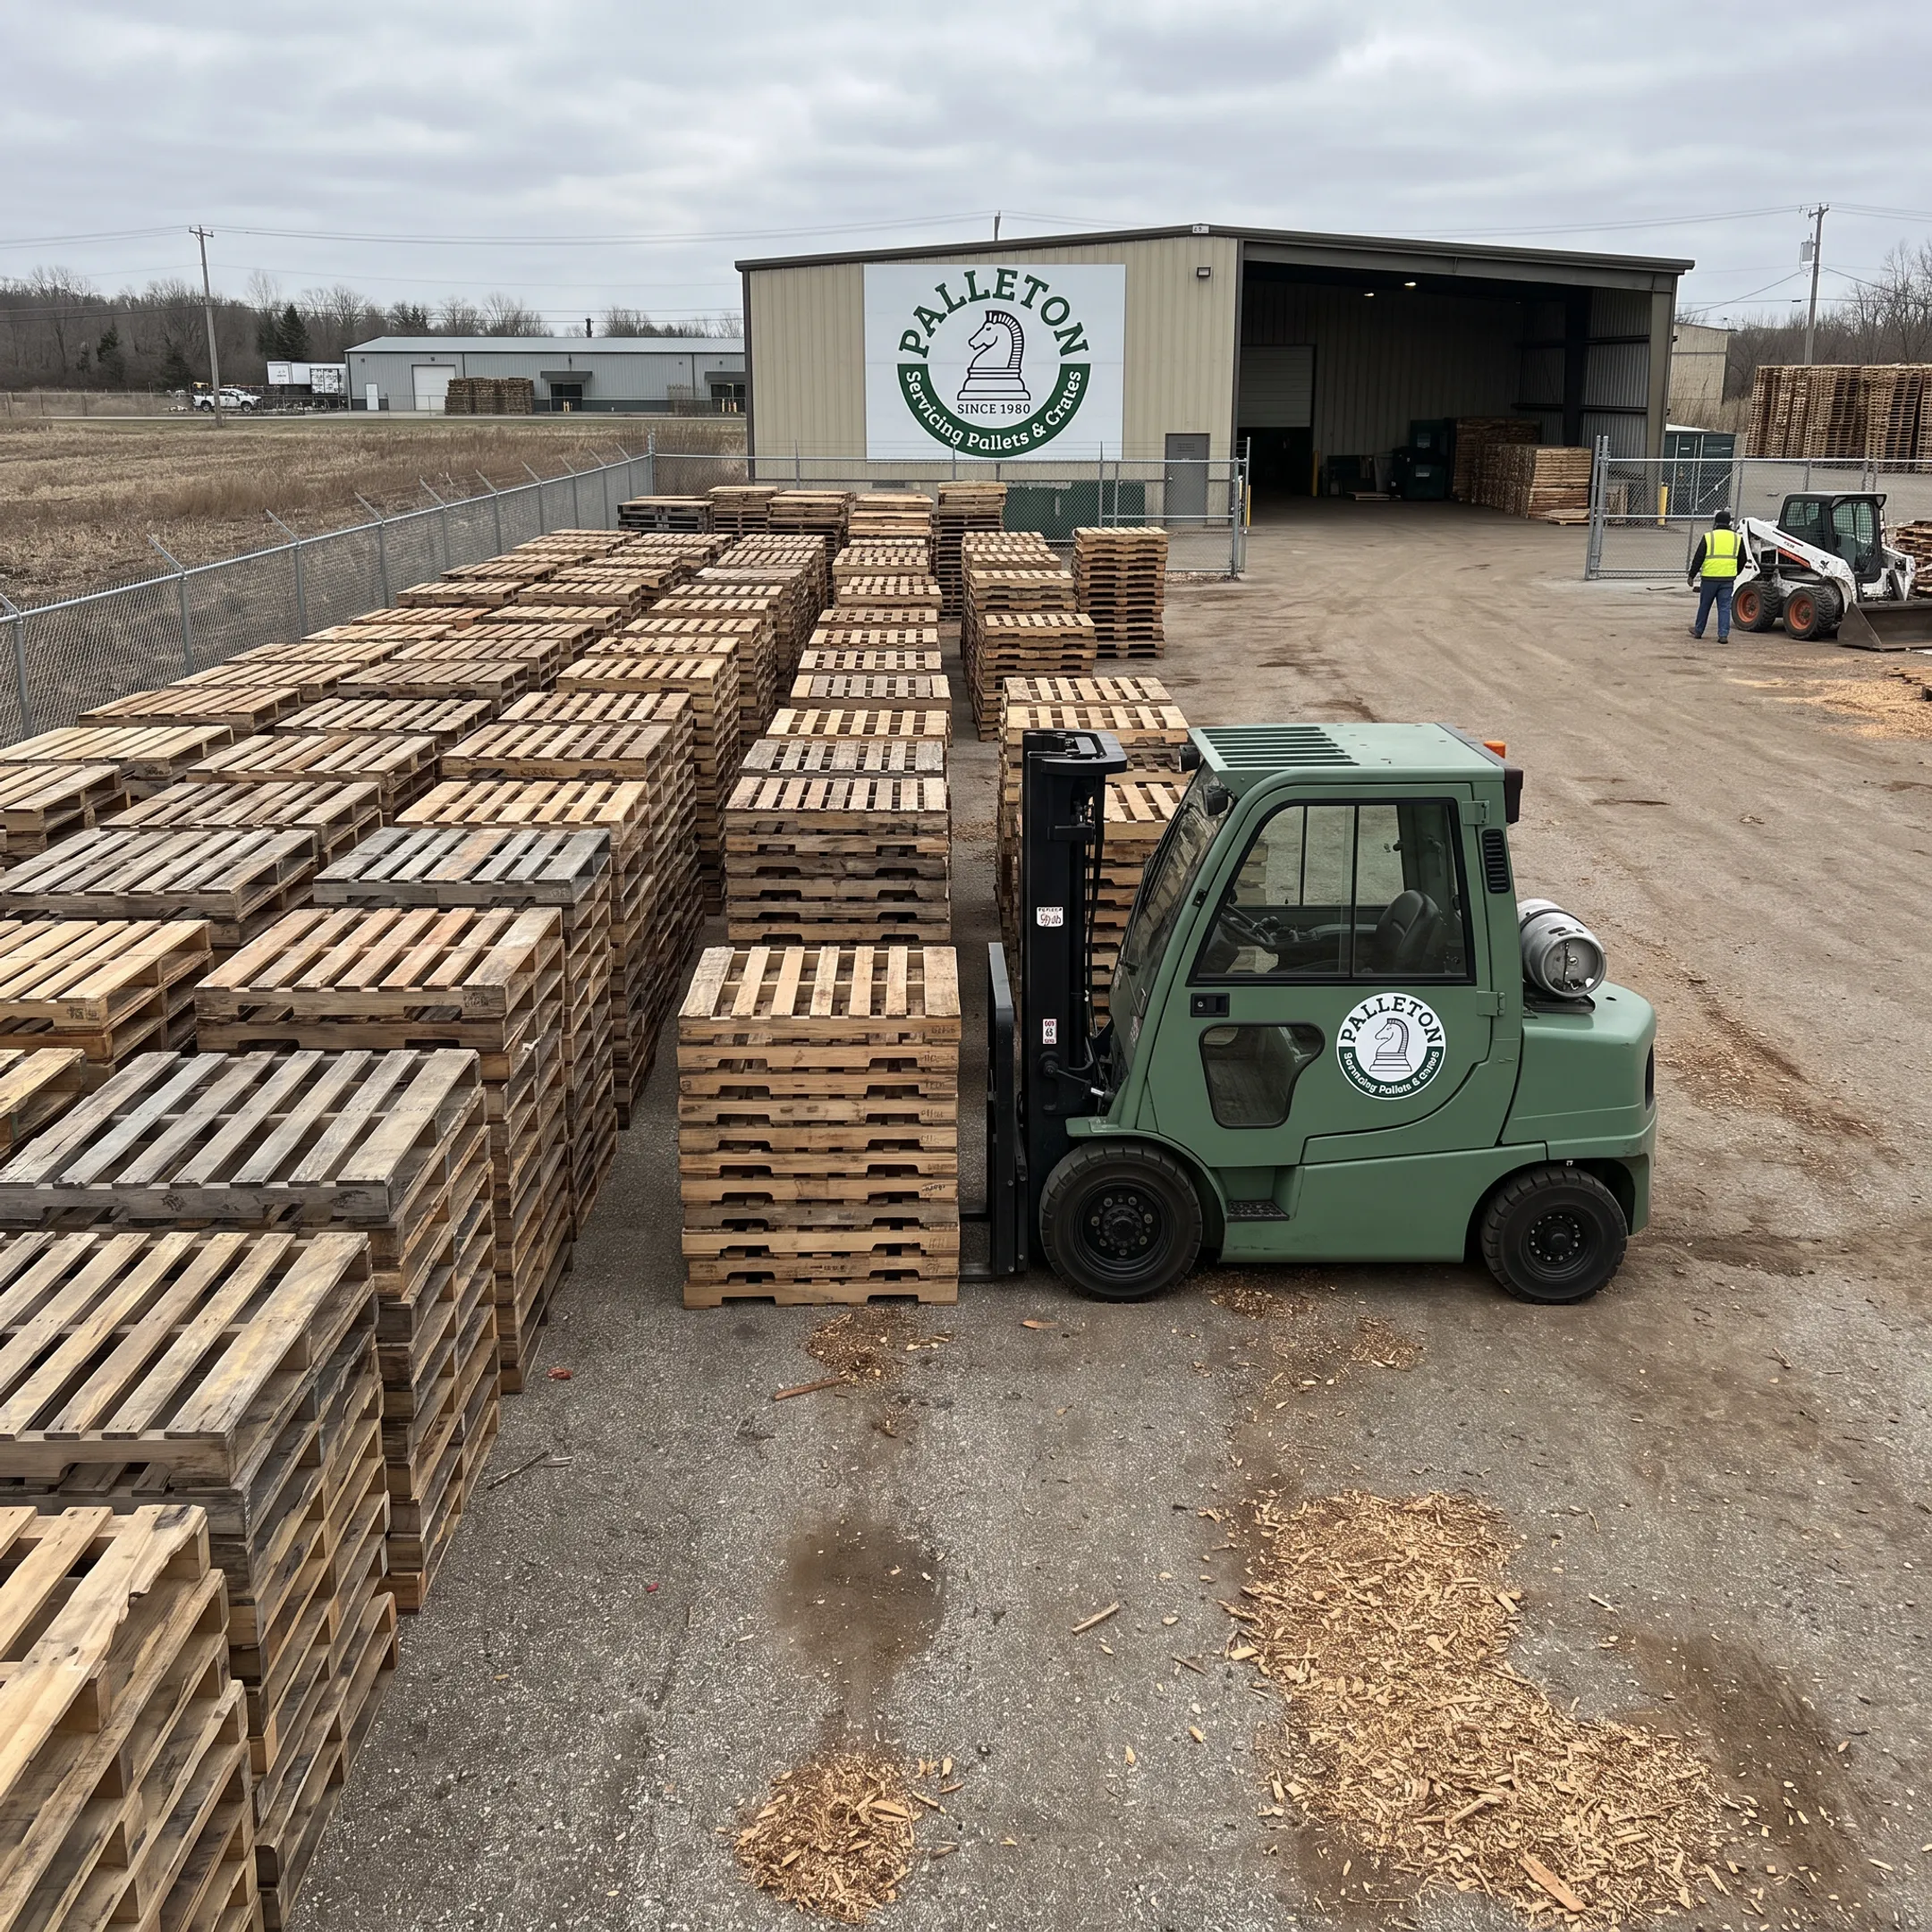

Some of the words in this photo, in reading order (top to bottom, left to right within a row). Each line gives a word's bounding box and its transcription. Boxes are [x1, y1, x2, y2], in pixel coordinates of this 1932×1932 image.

[899, 267, 1089, 359] PALLETON
[905, 370, 964, 445] Servicing
[966, 430, 1030, 450] Pallets
[1031, 422, 1046, 438] &
[1045, 370, 1081, 426] Crates
[957, 403, 996, 414] SINCE
[1000, 403, 1030, 414] 1980
[1340, 996, 1443, 1043] PALLETON
